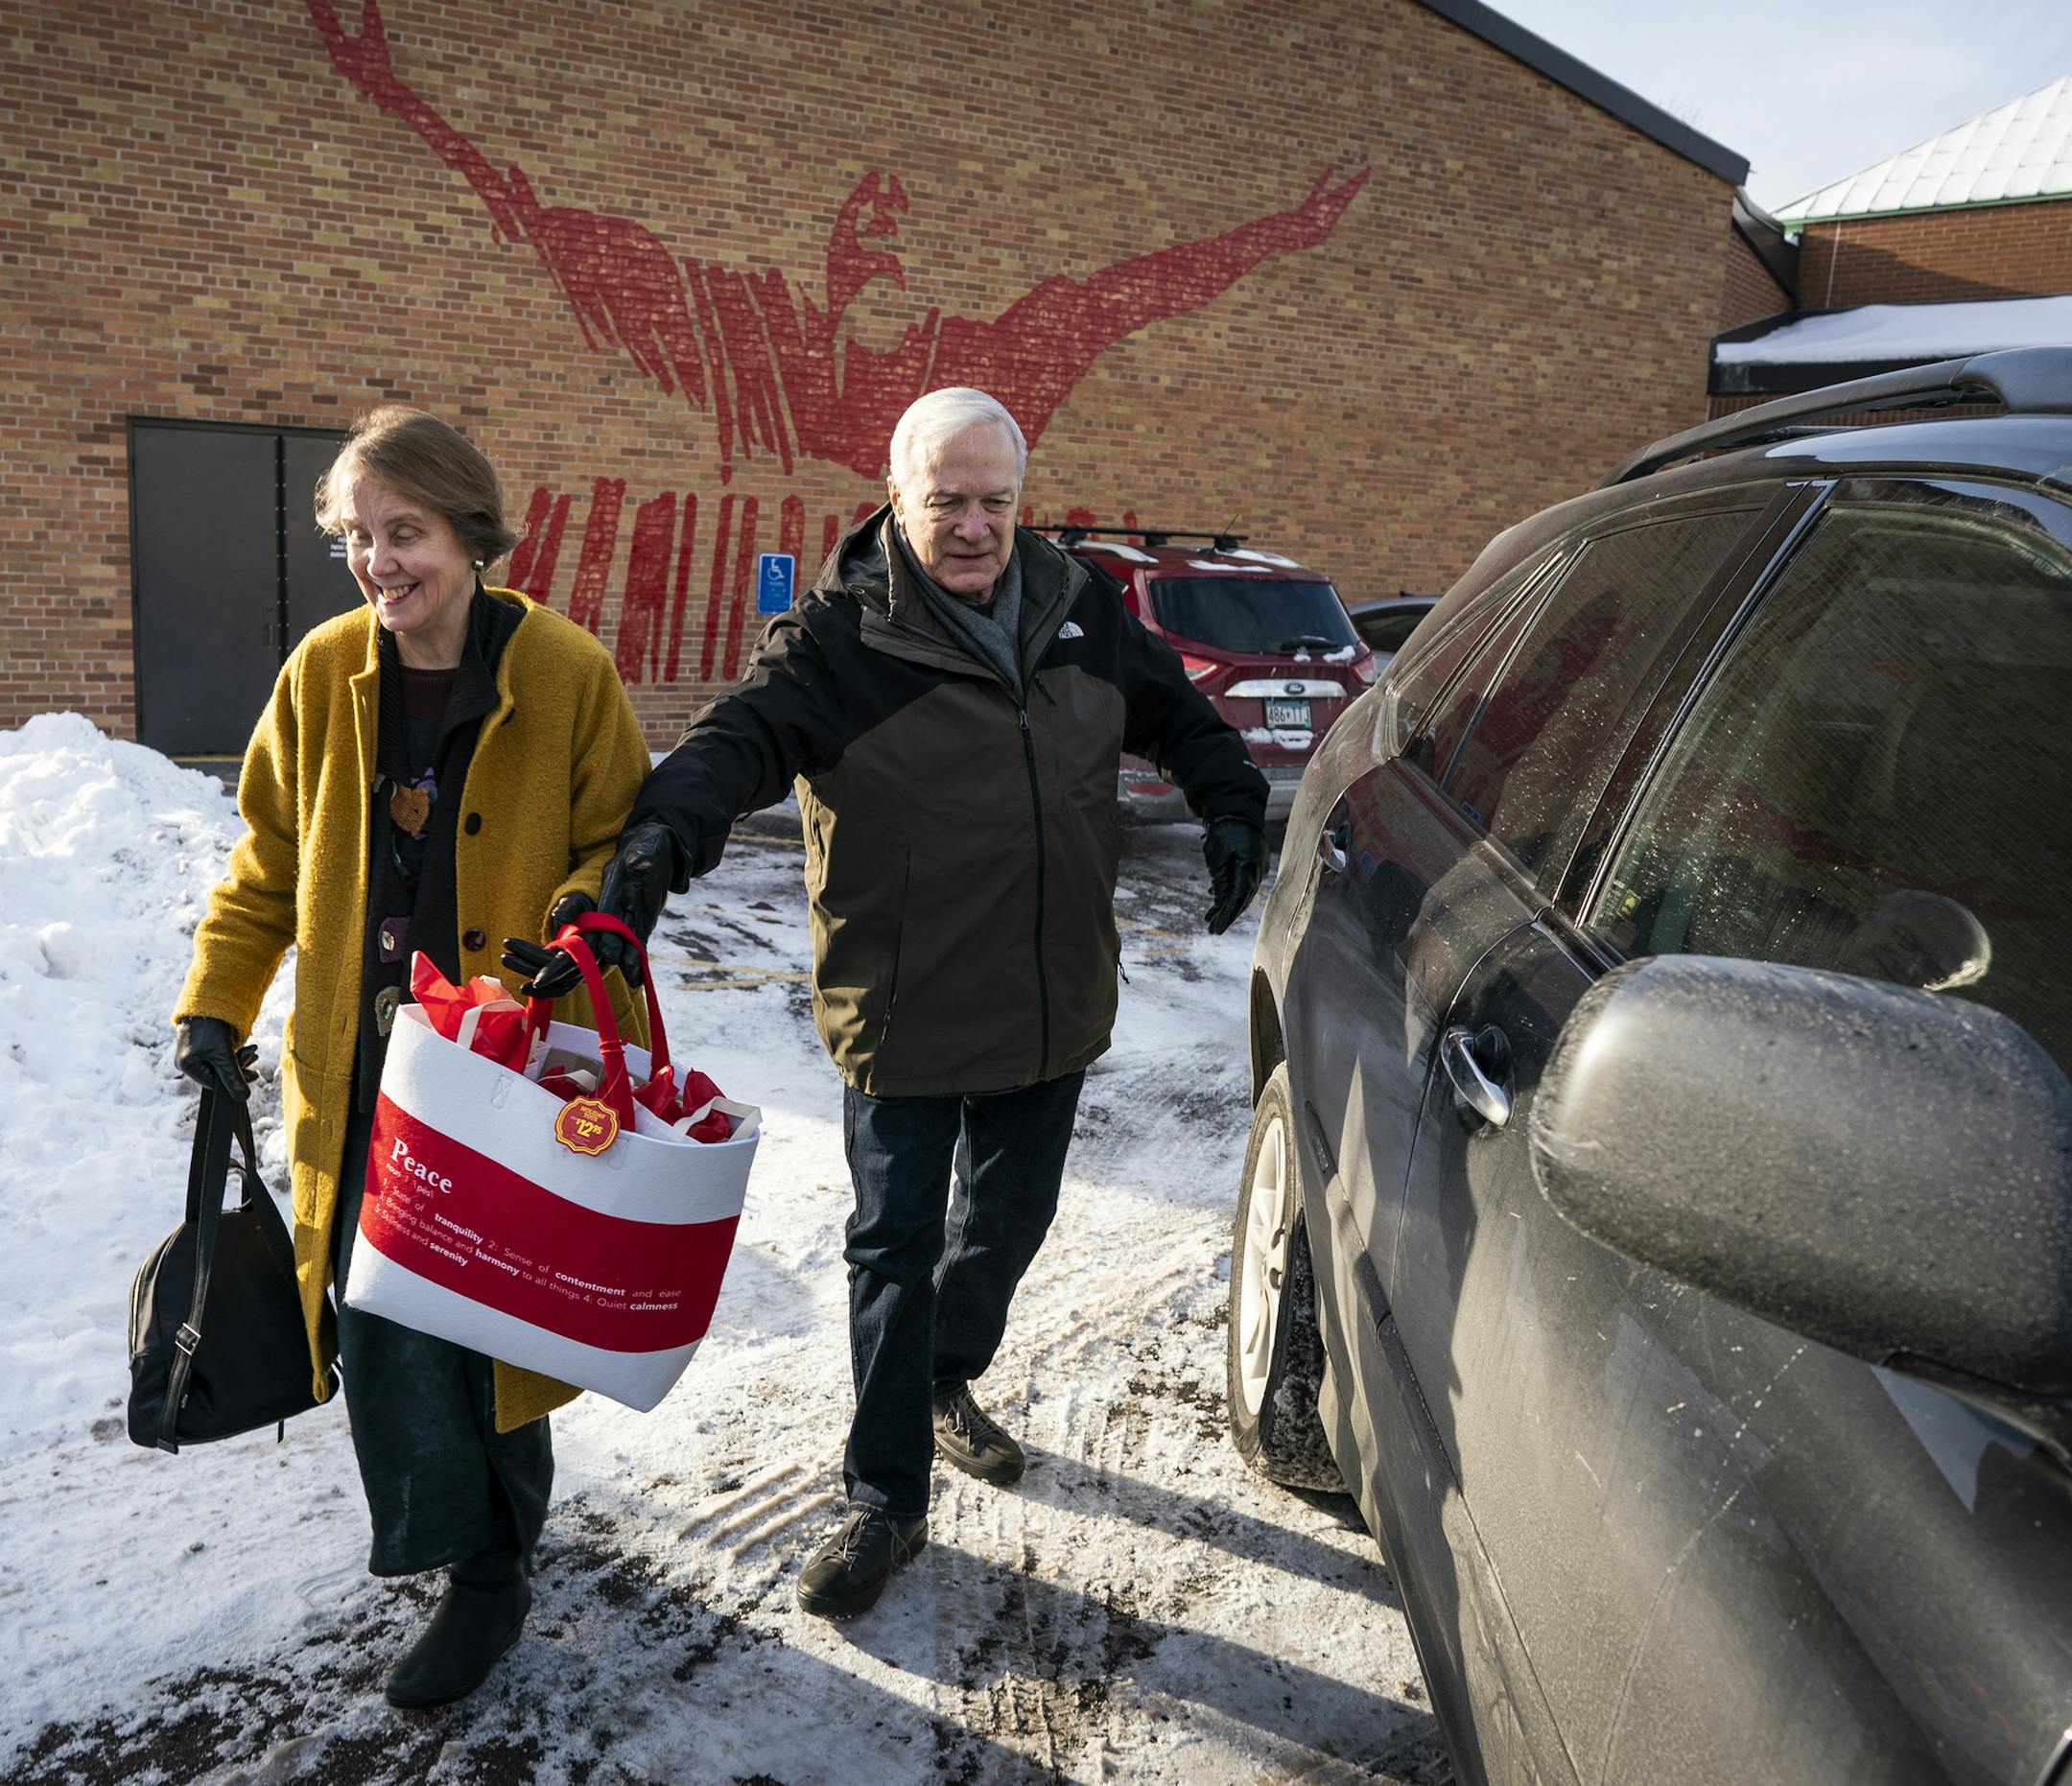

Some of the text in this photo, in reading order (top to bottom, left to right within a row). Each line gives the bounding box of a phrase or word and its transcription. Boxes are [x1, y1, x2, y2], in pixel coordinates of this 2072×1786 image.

[389, 1137, 453, 1194] Peace
[380, 1210, 411, 1236] Stillness
[412, 1233, 429, 1246] and
[429, 1242, 469, 1267] serenity
[386, 1197, 417, 1227] Bringing
[418, 1219, 454, 1244] balance
[455, 1240, 474, 1254] and
[475, 1248, 520, 1277] harmony
[522, 1271, 532, 1281] to
[534, 1277, 547, 1287] all
[549, 1281, 580, 1301] things
[597, 1297, 627, 1310] Quiet
[629, 1302, 679, 1312] calmness
[414, 1203, 425, 1211] of
[435, 1213, 483, 1245] tranquility
[504, 1248, 532, 1267] Sense
[538, 1265, 550, 1274] of
[554, 1272, 626, 1297] contentment
[631, 1289, 653, 1299] and
